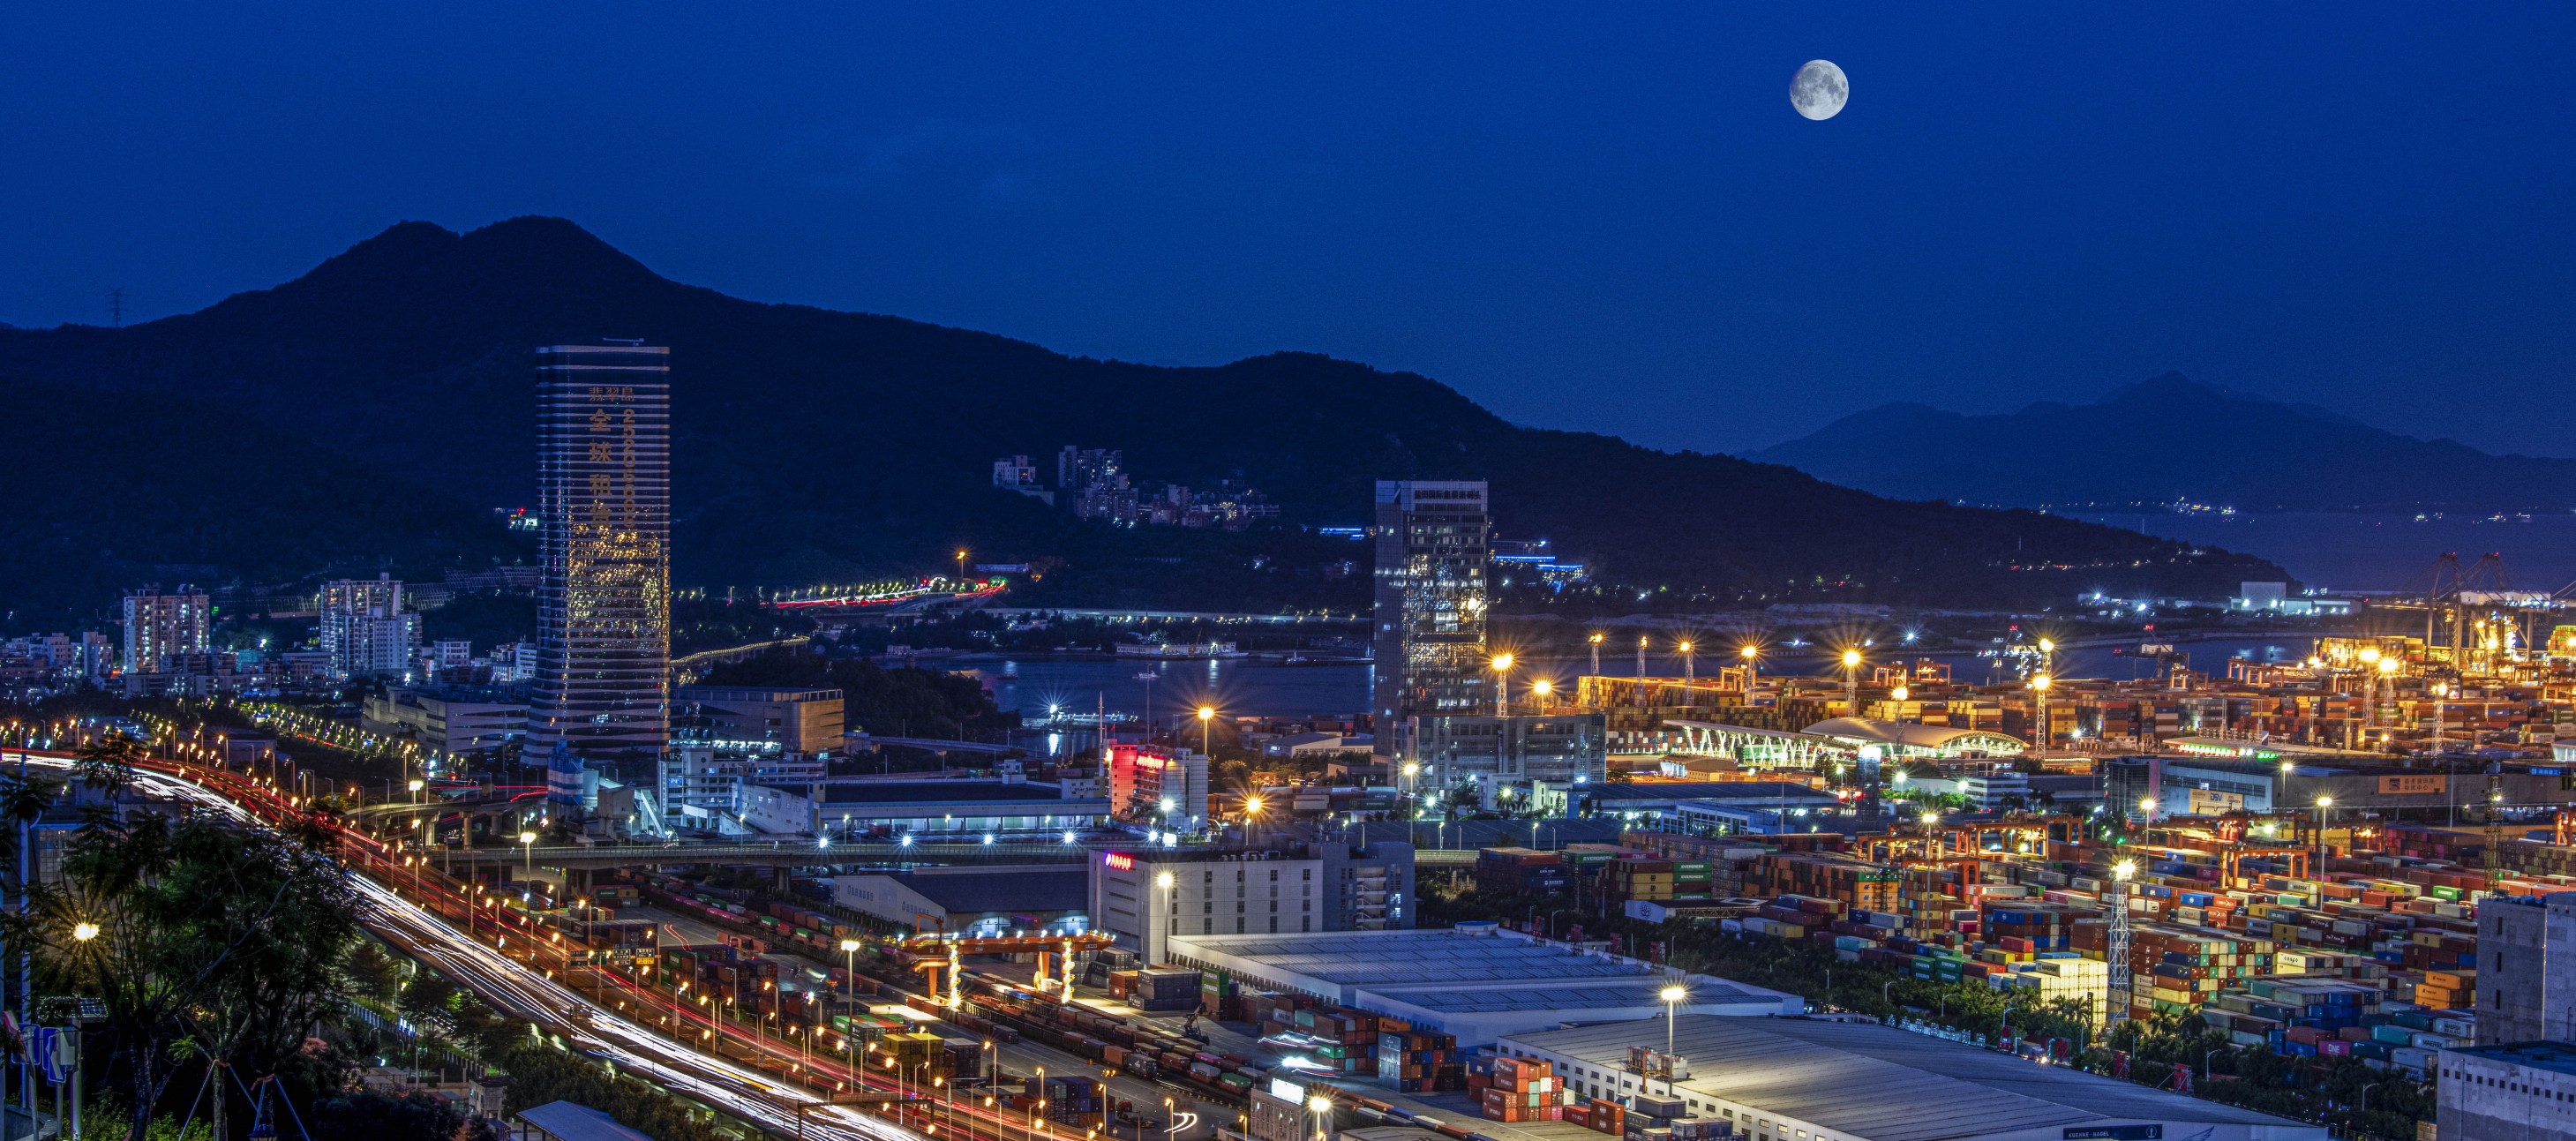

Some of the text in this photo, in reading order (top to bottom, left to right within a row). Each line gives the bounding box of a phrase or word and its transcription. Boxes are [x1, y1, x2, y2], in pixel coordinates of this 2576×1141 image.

[2210, 792, 2222, 801] DSV
[2422, 1039, 2443, 1047] MAERSK
[2328, 1043, 2339, 1053] ONE
